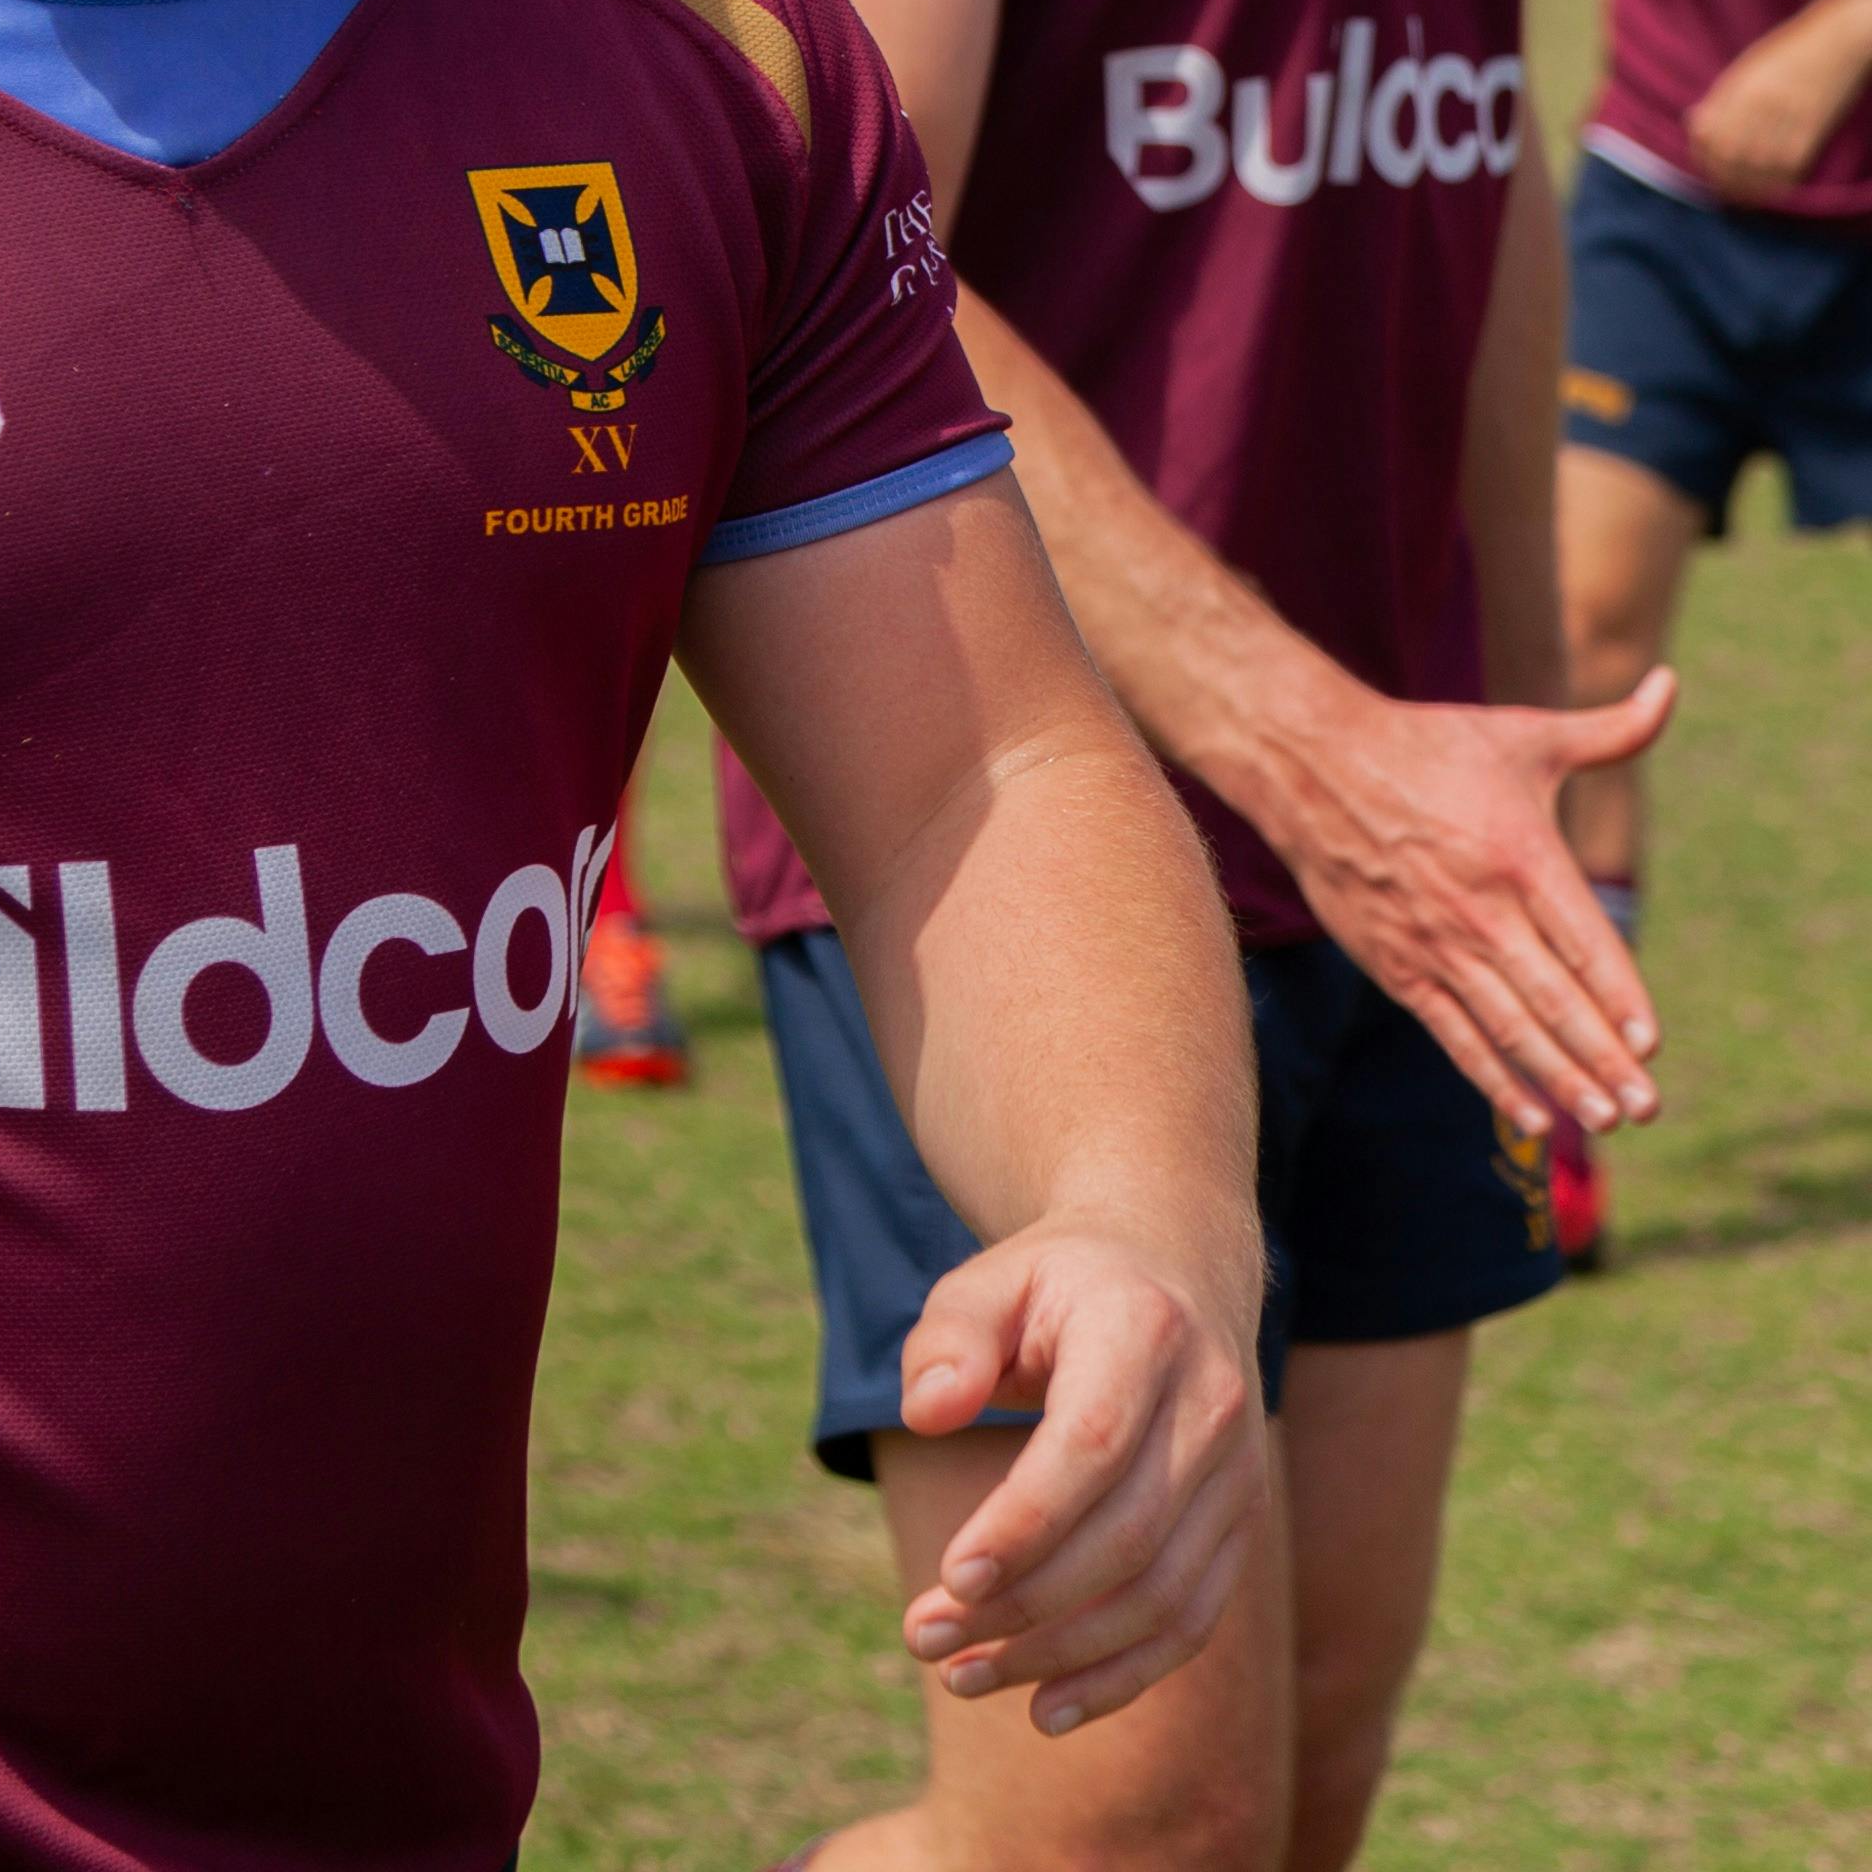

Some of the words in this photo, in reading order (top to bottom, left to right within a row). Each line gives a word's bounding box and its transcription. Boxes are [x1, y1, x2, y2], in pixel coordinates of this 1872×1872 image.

[590, 393, 610, 409] AC
[568, 424, 638, 474] XV
[484, 503, 615, 537] FOURTH
[622, 494, 689, 527] GRADE
